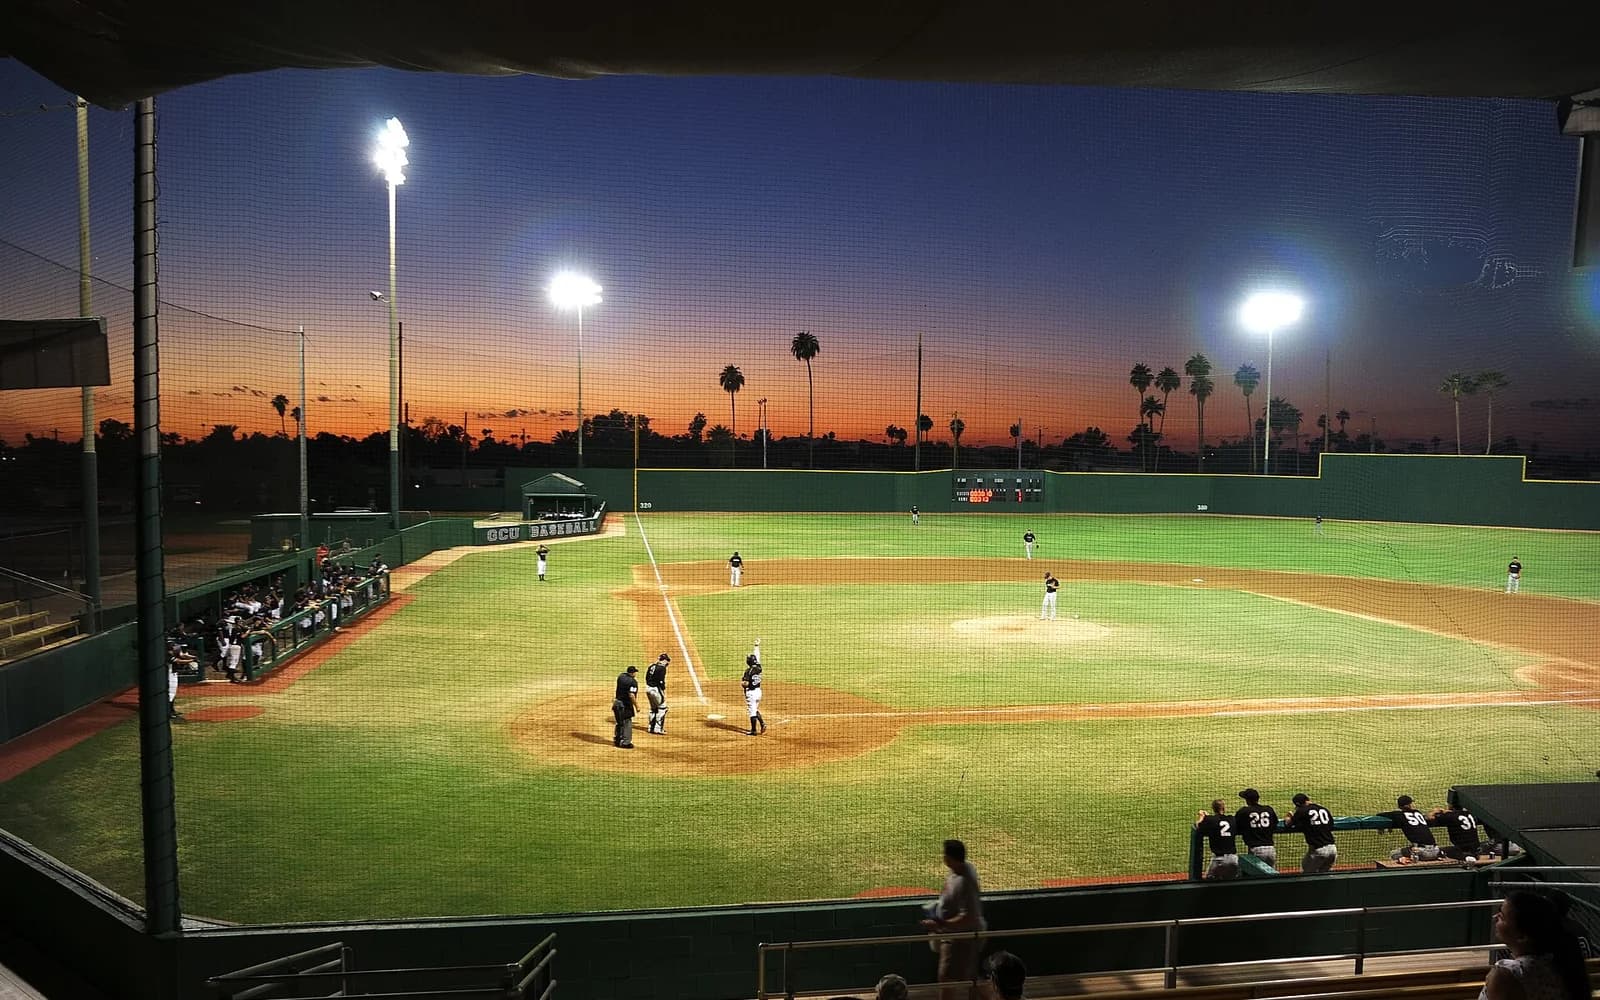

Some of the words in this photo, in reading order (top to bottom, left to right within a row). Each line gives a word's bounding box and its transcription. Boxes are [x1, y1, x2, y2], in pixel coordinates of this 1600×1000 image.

[487, 527, 520, 542] GCU
[530, 520, 597, 538] BASEBALL
[1249, 811, 1271, 828] 26
[1308, 809, 1330, 826] 20
[1403, 811, 1428, 827] 50
[1458, 813, 1477, 831] 31
[1219, 820, 1232, 837] 2
